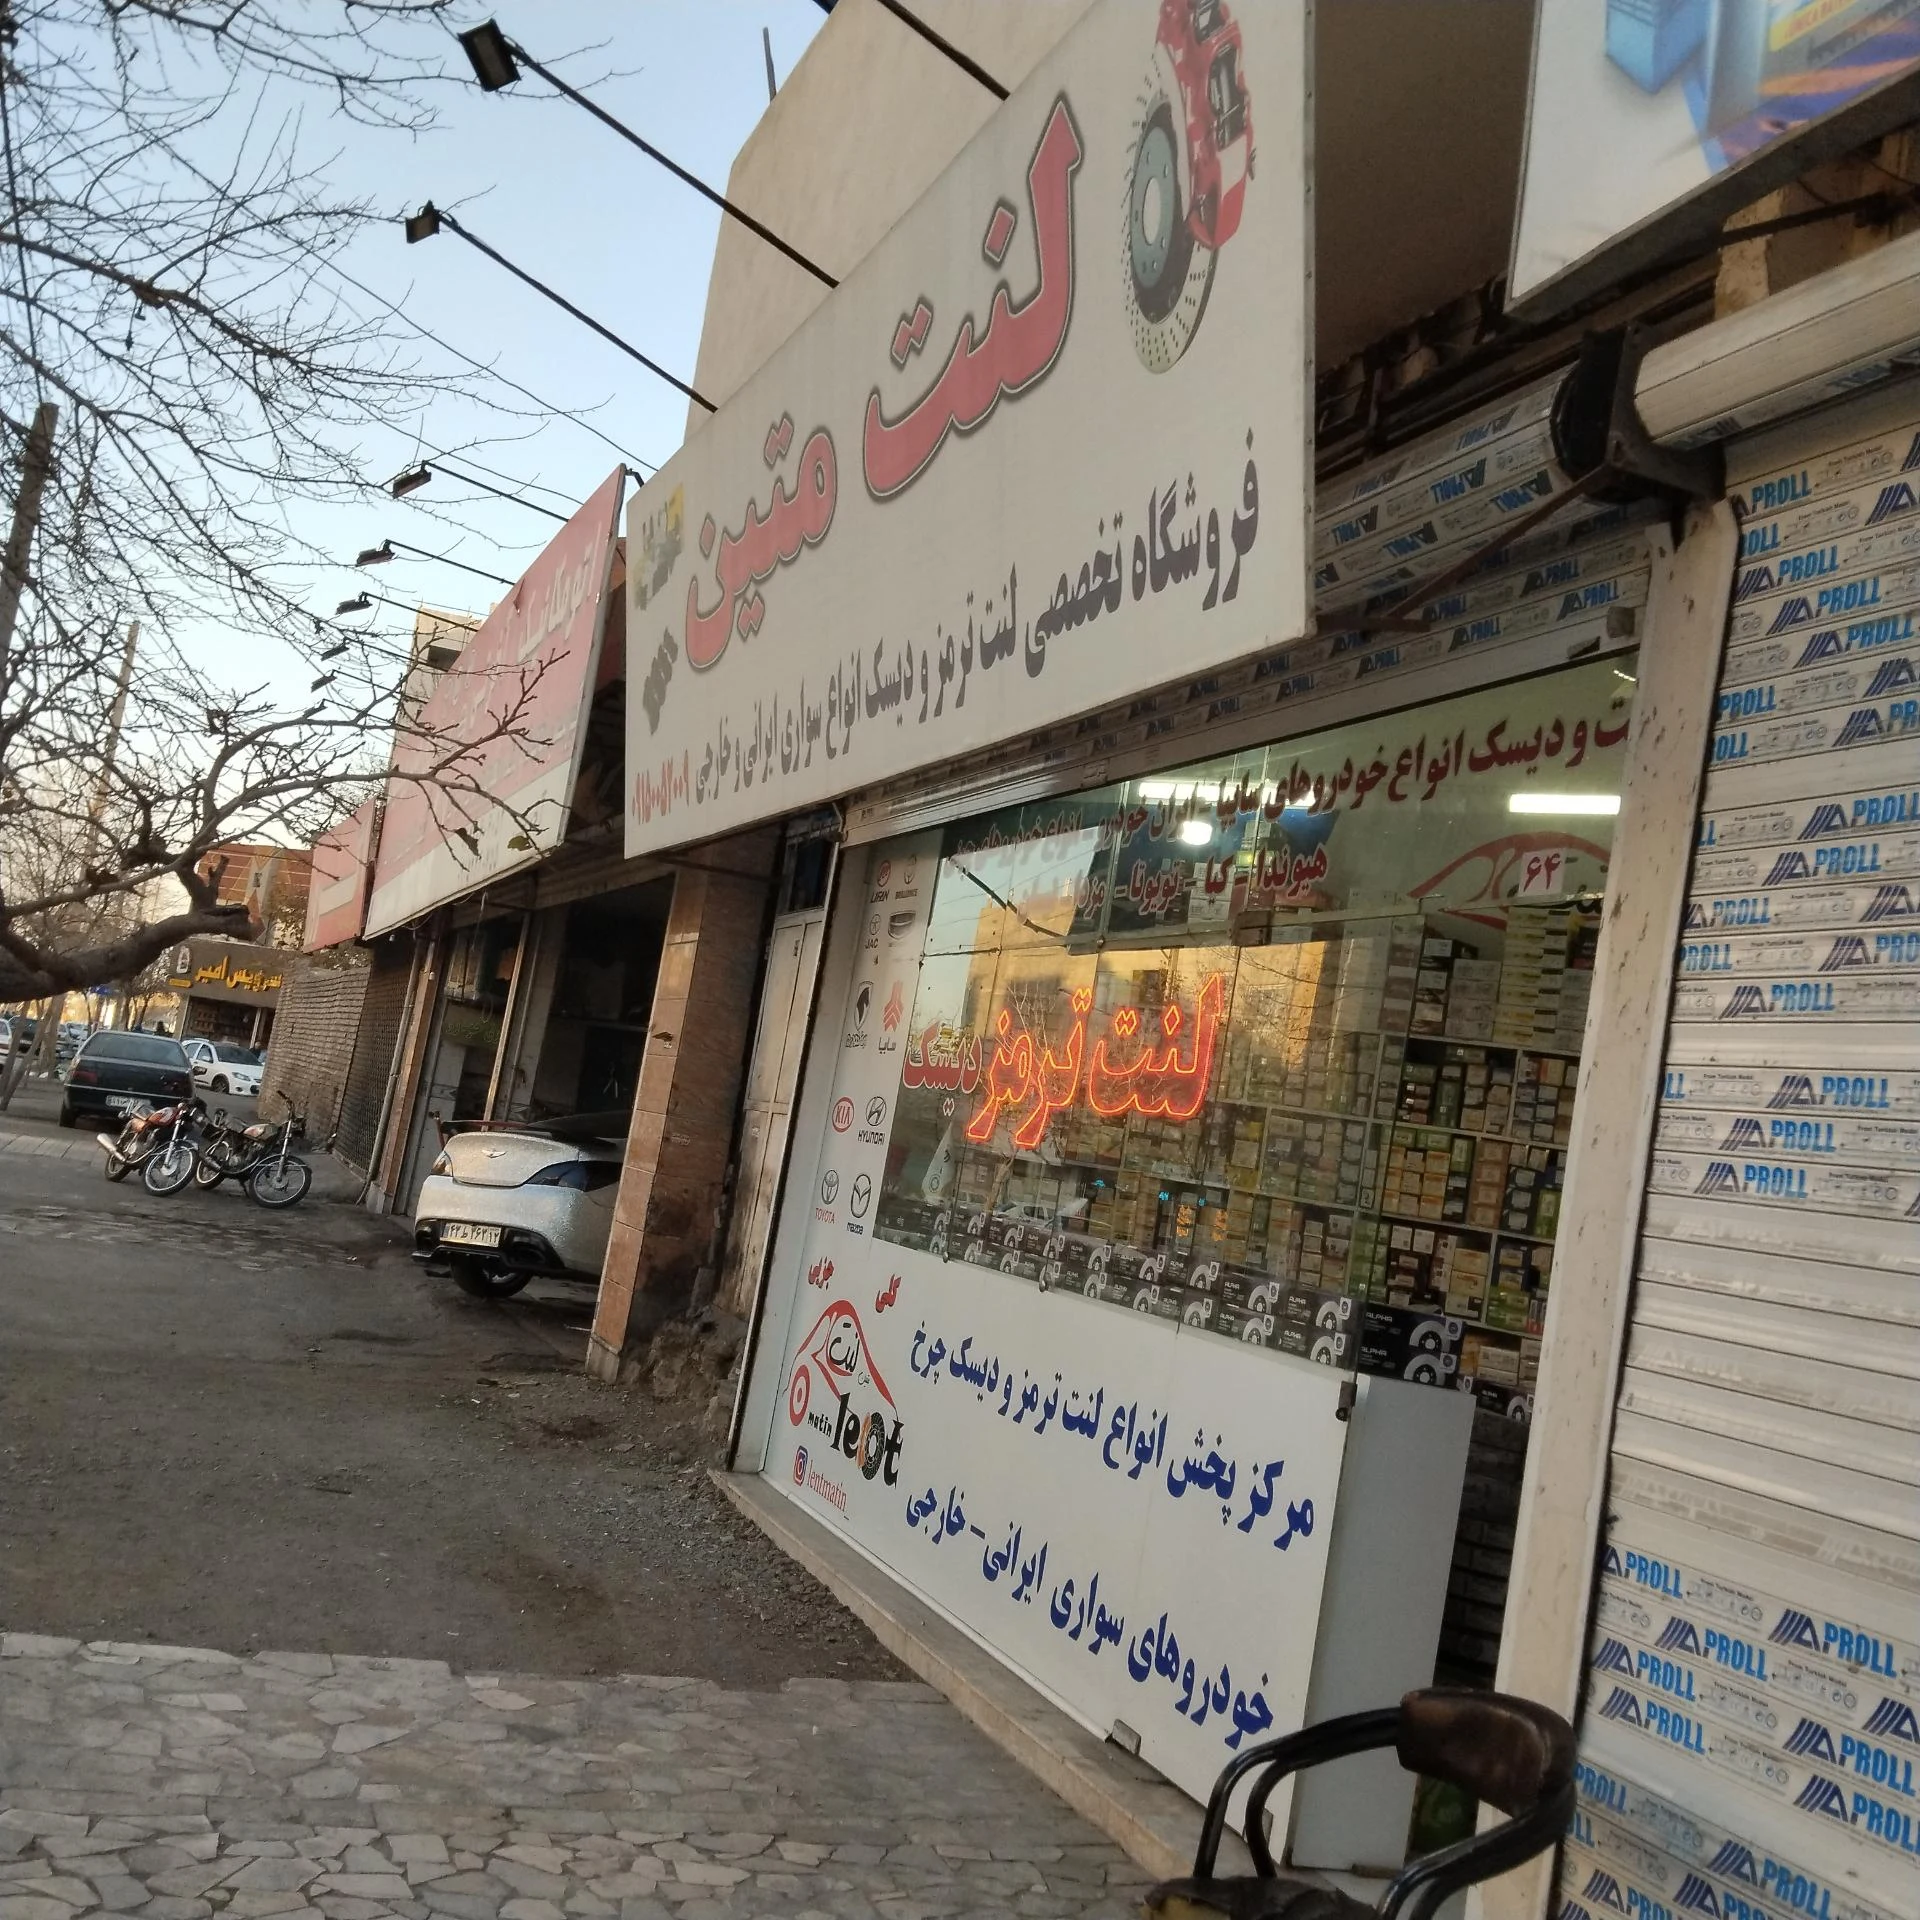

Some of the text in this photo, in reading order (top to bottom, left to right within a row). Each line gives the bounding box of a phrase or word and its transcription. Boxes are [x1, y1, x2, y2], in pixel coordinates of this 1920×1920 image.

[684, 89, 1084, 672] لنت متین
[695, 427, 1259, 804] فروشگاه تخصصی لنت ترمز و دیسک انواع سواری ایرانی و خارجی
[1387, 729, 1465, 801] انواع
[1468, 716, 1565, 774] دیسک
[1565, 719, 1588, 768] و
[1264, 745, 1388, 823] خودروهای
[1129, 859, 1182, 915] تویوتا
[1205, 855, 1235, 904] کیا
[1256, 843, 1328, 898] هیوندا
[864, 938, 879, 950] JAC
[902, 973, 1223, 1147] لنت ترمز دیسک
[835, 1104, 851, 1125] KIA
[857, 1128, 886, 1146] HYUNDAI
[815, 1207, 835, 1225] TOYOTA
[875, 1273, 902, 1313] کلی
[1224, 1281, 1240, 1290] ALPHA
[1289, 1296, 1306, 1305] ALPHA
[1219, 1312, 1235, 1321] ALPHA
[1283, 1330, 1301, 1339] ALPHA
[1365, 1311, 1393, 1323] ALPHA
[829, 1322, 860, 1372] لنت
[1360, 1346, 1387, 1356] ALPHA
[807, 1411, 833, 1437] matin
[910, 1320, 1314, 1551] مرکز پخش انواع لنت ترمز و دیسک چرخ
[906, 1485, 1274, 1751] خودروهای سواری ایرانی خارجی
